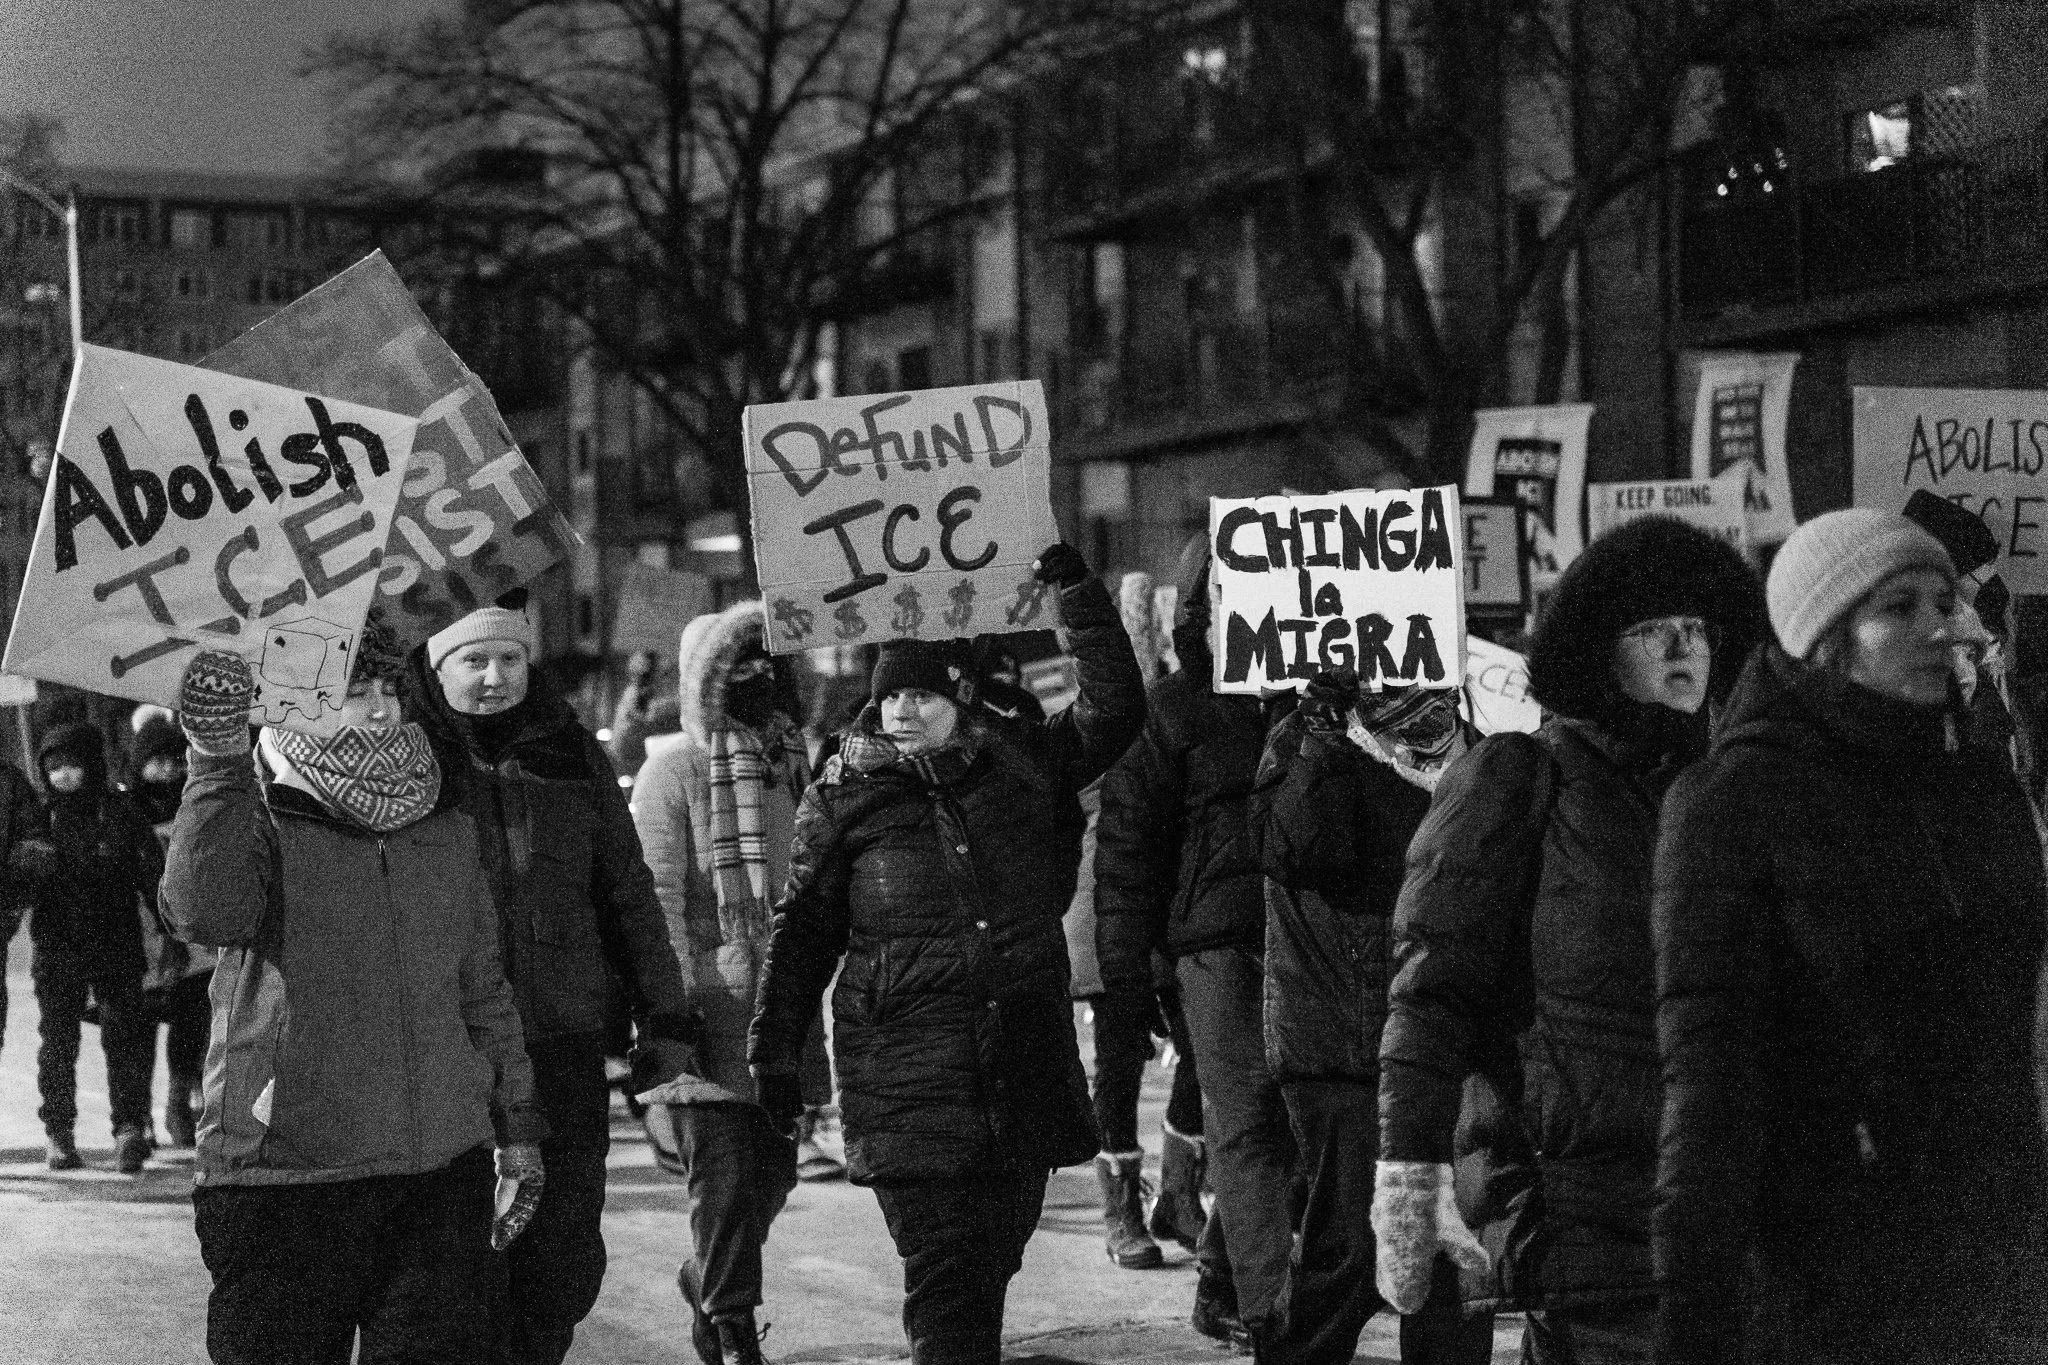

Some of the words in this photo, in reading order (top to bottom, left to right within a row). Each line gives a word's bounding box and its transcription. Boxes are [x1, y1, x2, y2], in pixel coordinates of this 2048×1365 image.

[55, 393, 390, 573] Abolish
[1616, 486, 1655, 509] KEEP
[803, 486, 998, 603] ICE
[1216, 489, 1453, 573] CHINGA
[94, 488, 384, 678] ICE
[1299, 567, 1343, 618] la
[1224, 605, 1445, 683] MIGRA
